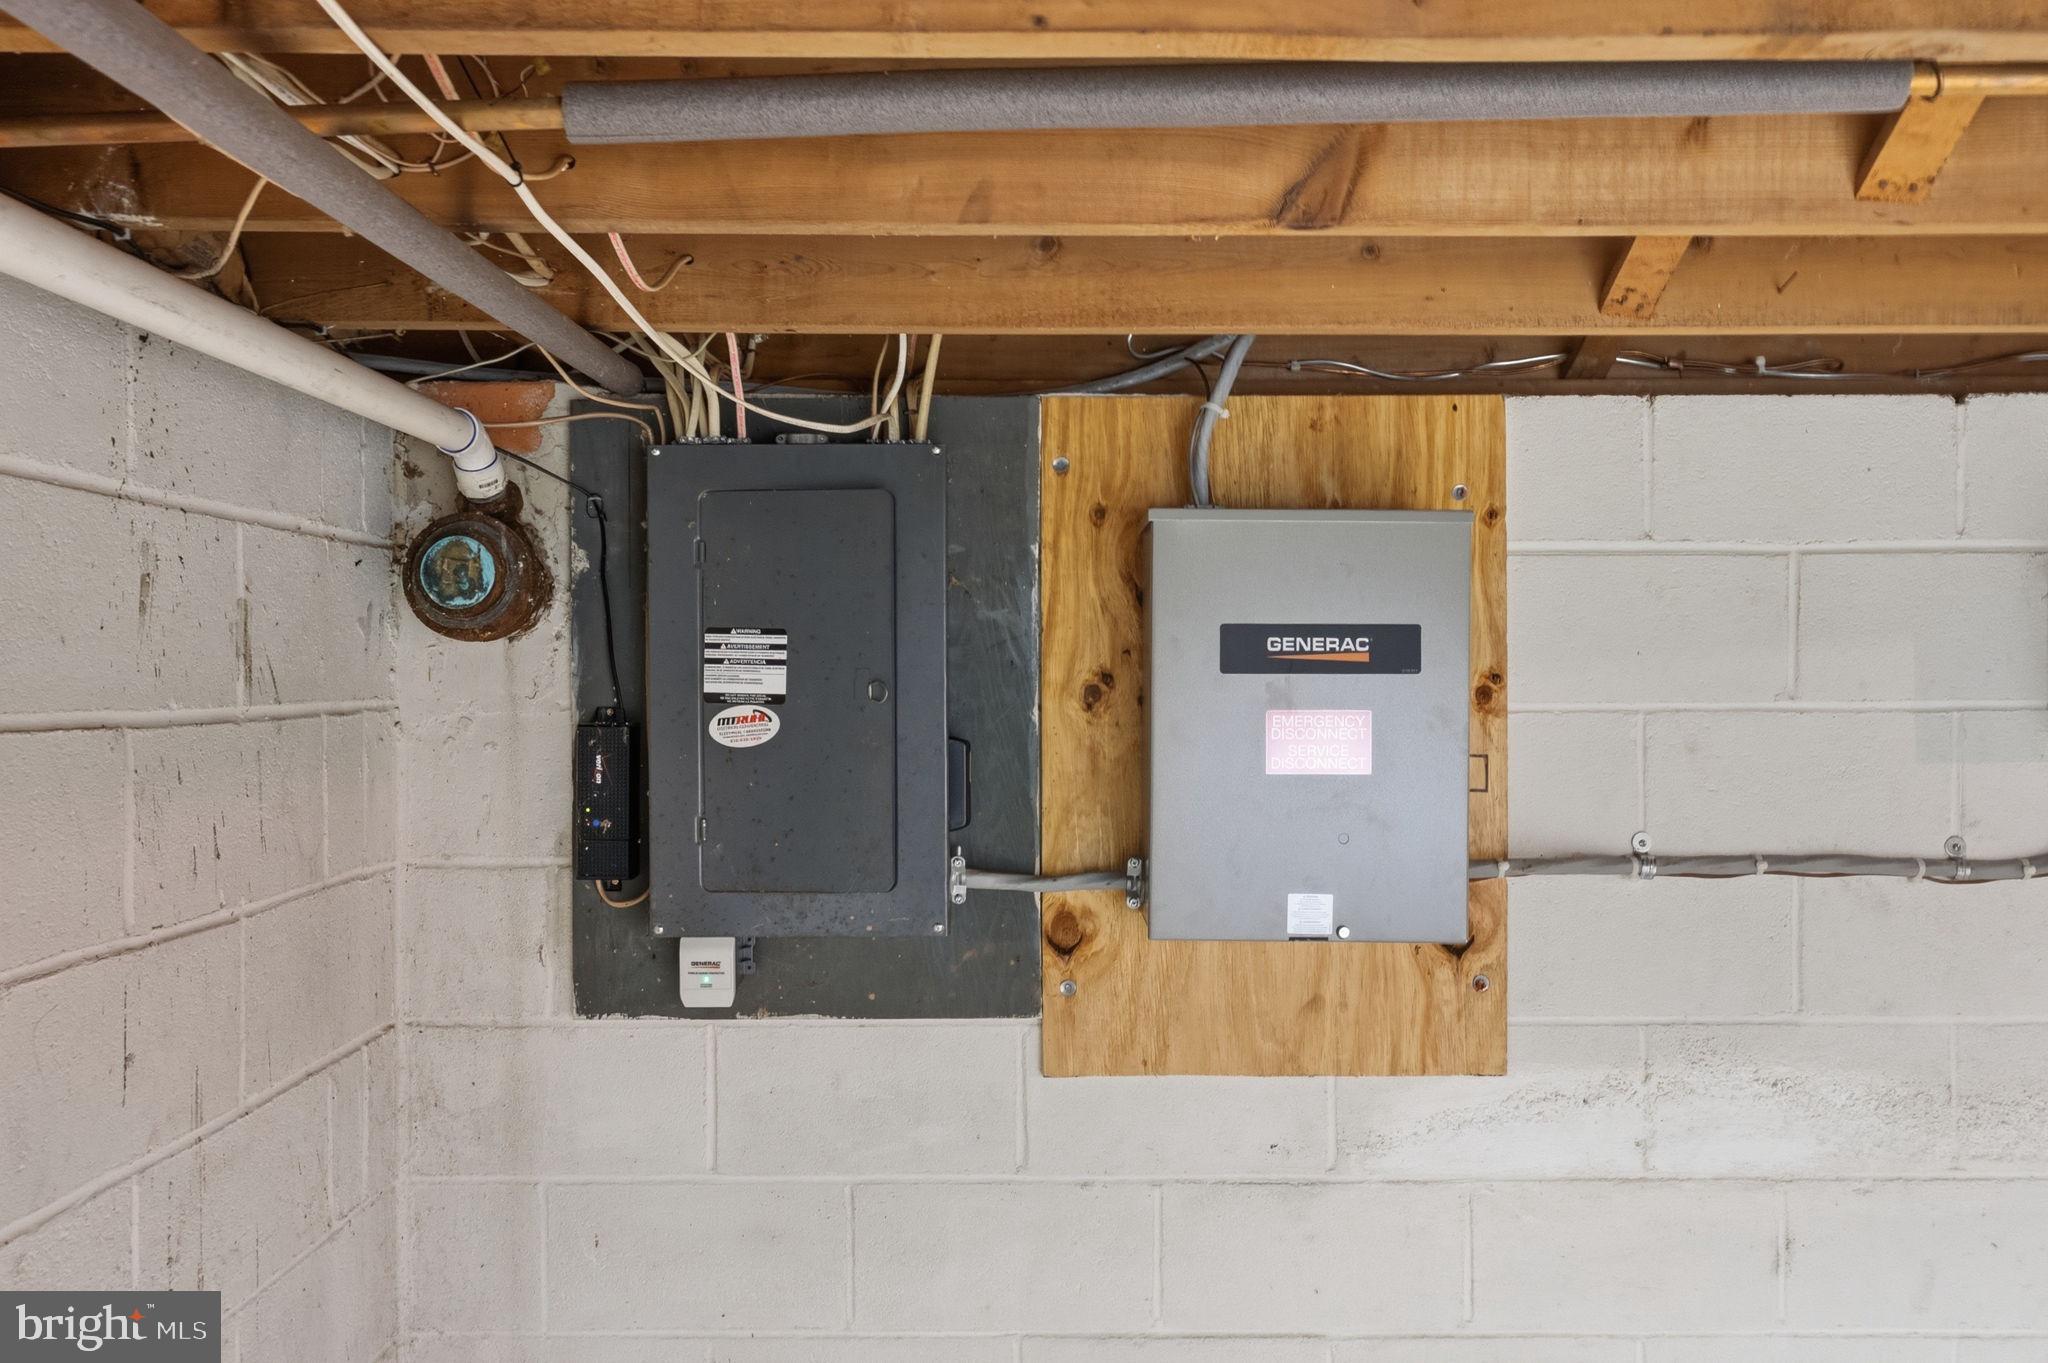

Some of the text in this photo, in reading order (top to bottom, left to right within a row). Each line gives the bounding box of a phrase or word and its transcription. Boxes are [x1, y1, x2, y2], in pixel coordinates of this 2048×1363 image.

[1267, 637, 1369, 651] GENERAC
[1272, 715, 1366, 727] EMERGENCY
[1271, 728, 1367, 740] DISCONNECT
[1288, 744, 1349, 757] SERVICE
[594, 754, 603, 784] verion
[1271, 757, 1367, 769] DISCONNECT
